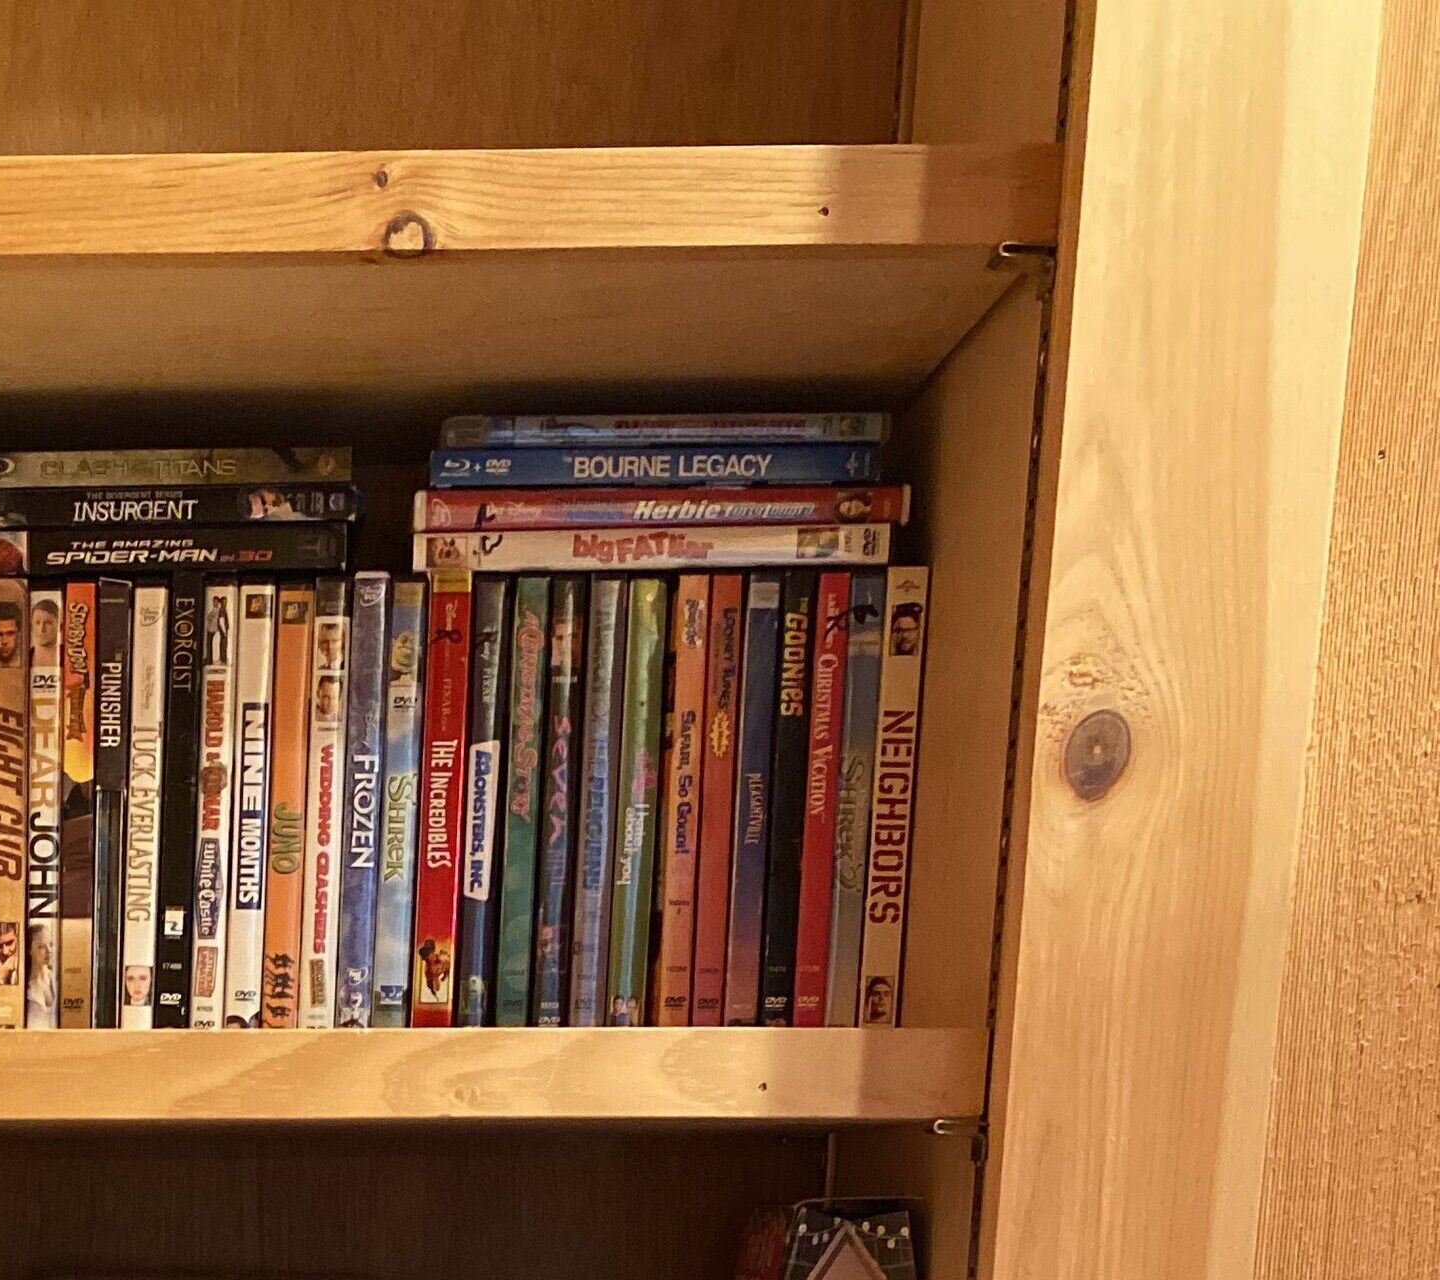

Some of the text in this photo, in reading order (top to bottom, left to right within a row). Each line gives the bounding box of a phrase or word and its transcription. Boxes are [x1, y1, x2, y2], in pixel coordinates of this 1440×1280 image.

[74, 499, 198, 521] INSURGENT
[573, 454, 772, 479] BOURNE LEGACY
[633, 500, 720, 522] Herbie
[47, 549, 218, 565] SPIDER-MAN
[173, 597, 194, 692] EXORCIST
[781, 613, 808, 716] GOONIES
[100, 662, 120, 747] PUNISHER
[810, 653, 839, 816] CHRISTMAS VACATION
[28, 699, 60, 920] DEAR JOHN
[239, 707, 266, 904] NINE MONTHS
[271, 803, 301, 875] JUNO
[313, 744, 334, 954] WEDDING CRASHERS
[350, 753, 380, 868] FROZEN
[384, 776, 414, 882] SHREK
[426, 739, 458, 868] THE INCREDIBLES
[471, 750, 492, 852] MONSTERS,
[869, 709, 915, 924] NEIGHBORS
[126, 786, 159, 923] EVERLASTING
